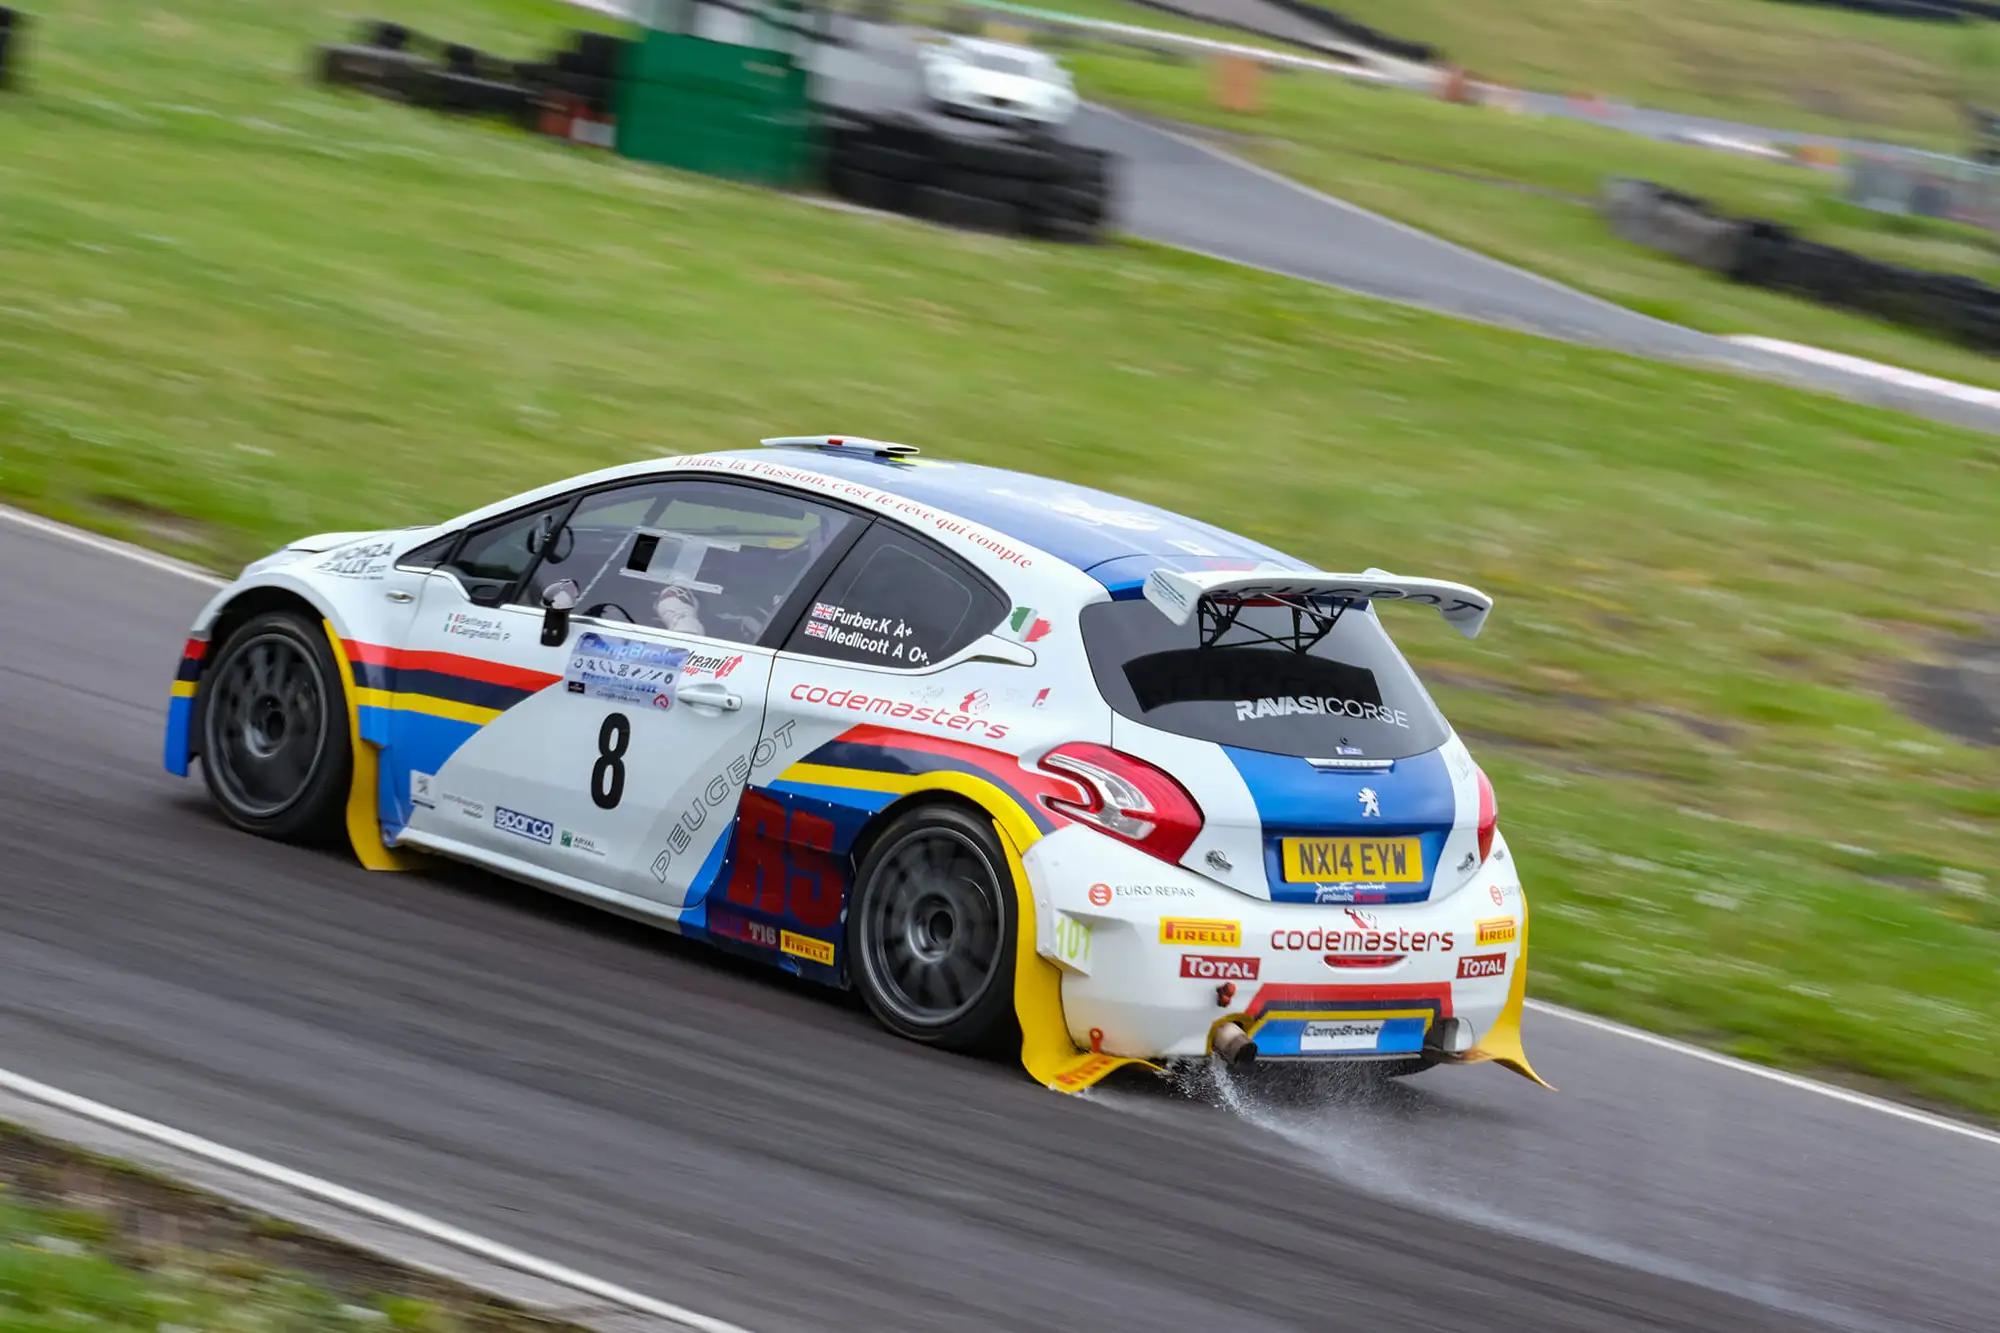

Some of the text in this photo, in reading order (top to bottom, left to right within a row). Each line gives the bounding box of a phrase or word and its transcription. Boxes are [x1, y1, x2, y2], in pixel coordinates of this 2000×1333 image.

[728, 459, 746, 471] la
[875, 493, 893, 506] le
[936, 516, 971, 535] qui
[968, 531, 1032, 570] compte
[825, 625, 890, 656] Medlicott
[892, 642, 904, 659] A
[790, 683, 1011, 740] codemasters
[590, 712, 631, 810] 8
[650, 719, 796, 884] PEUGEOT
[496, 809, 552, 839] sparco
[1299, 843, 1407, 876] NX14 EYW
[1115, 885, 1195, 898] EURO REPAR
[1165, 921, 1236, 943] PIRELLI
[1271, 926, 1454, 951] codemasters
[1479, 920, 1515, 942] PIRELLI
[783, 933, 831, 962] PIRELLI
[1185, 956, 1255, 979] TOTAL
[1461, 957, 1505, 977] TOTAL
